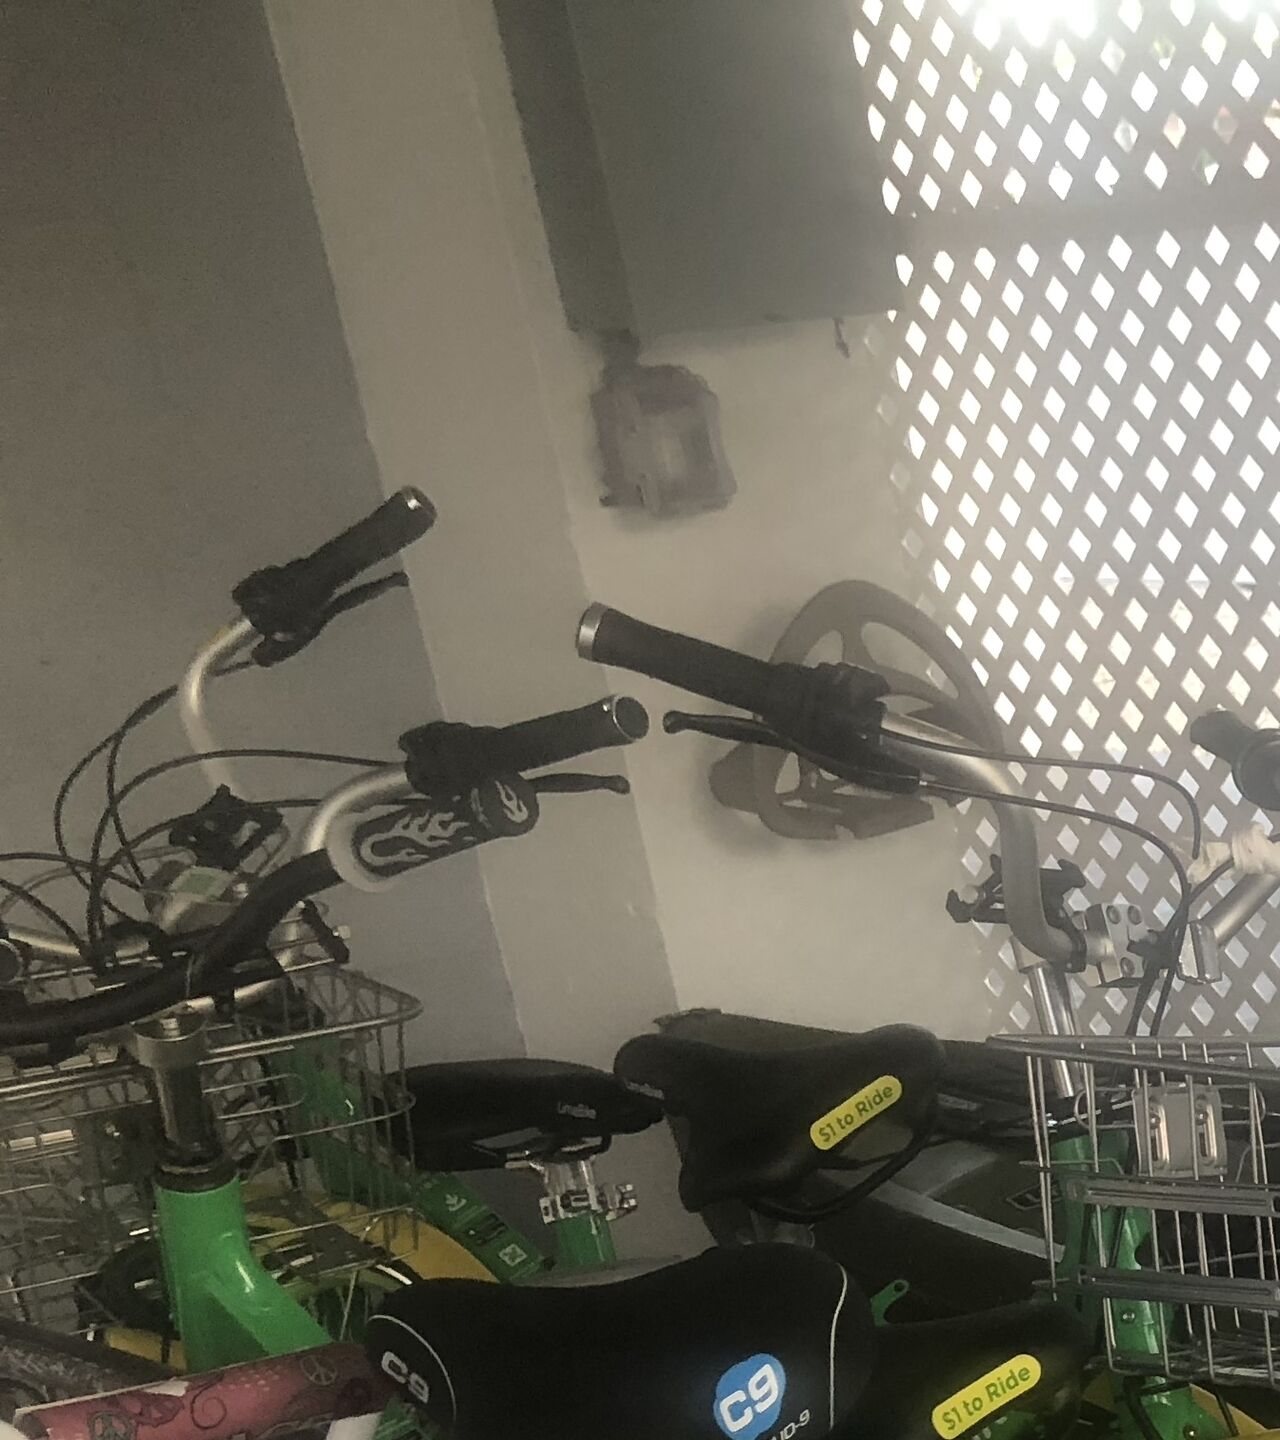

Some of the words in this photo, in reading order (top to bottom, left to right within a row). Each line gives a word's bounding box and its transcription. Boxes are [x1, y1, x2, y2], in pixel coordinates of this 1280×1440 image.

[818, 1123, 836, 1142] $1
[836, 1113, 854, 1129] to
[855, 1086, 893, 1117] Ride
[381, 1351, 429, 1404] C9
[720, 1363, 778, 1432] C9
[942, 1407, 962, 1430] $1
[963, 1397, 983, 1416] to
[985, 1367, 1030, 1403] Ride
